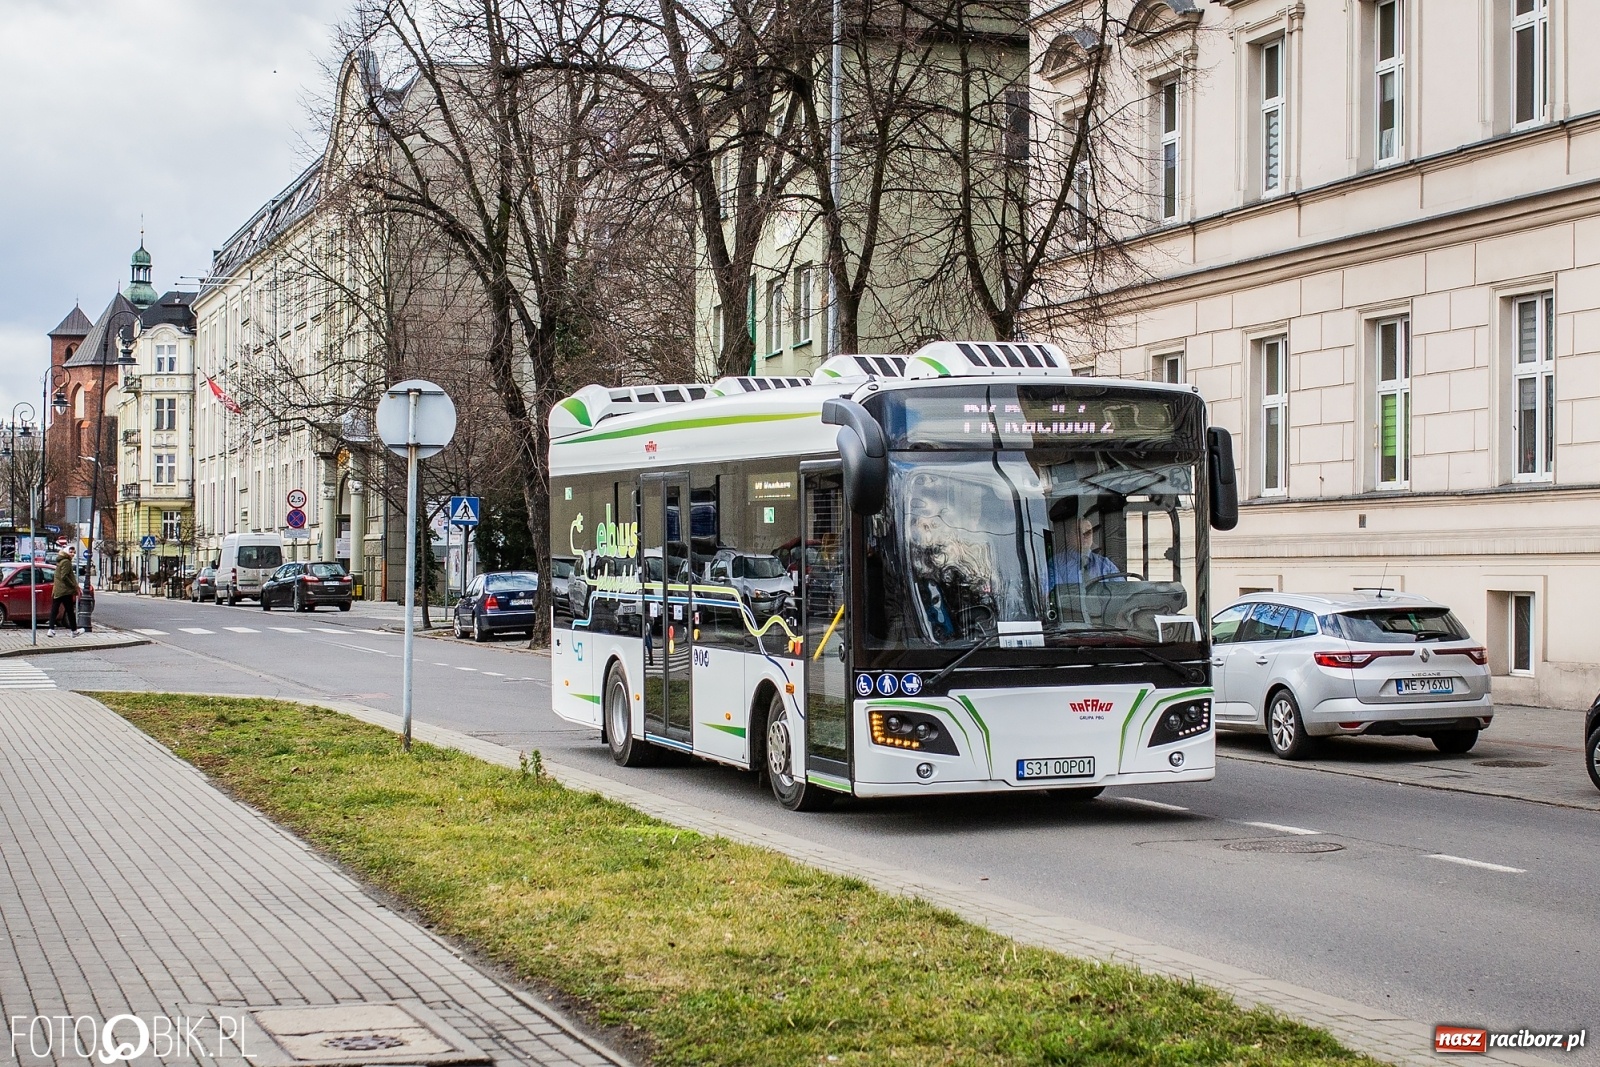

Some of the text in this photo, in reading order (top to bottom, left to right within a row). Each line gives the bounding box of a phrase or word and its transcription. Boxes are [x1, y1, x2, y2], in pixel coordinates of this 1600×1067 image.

[290, 494, 304, 503] 2,5t
[596, 503, 638, 558] ebus
[1404, 679, 1450, 691] WE 916XU
[1069, 699, 1113, 712] RAFAKO
[1026, 761, 1049, 776] S31
